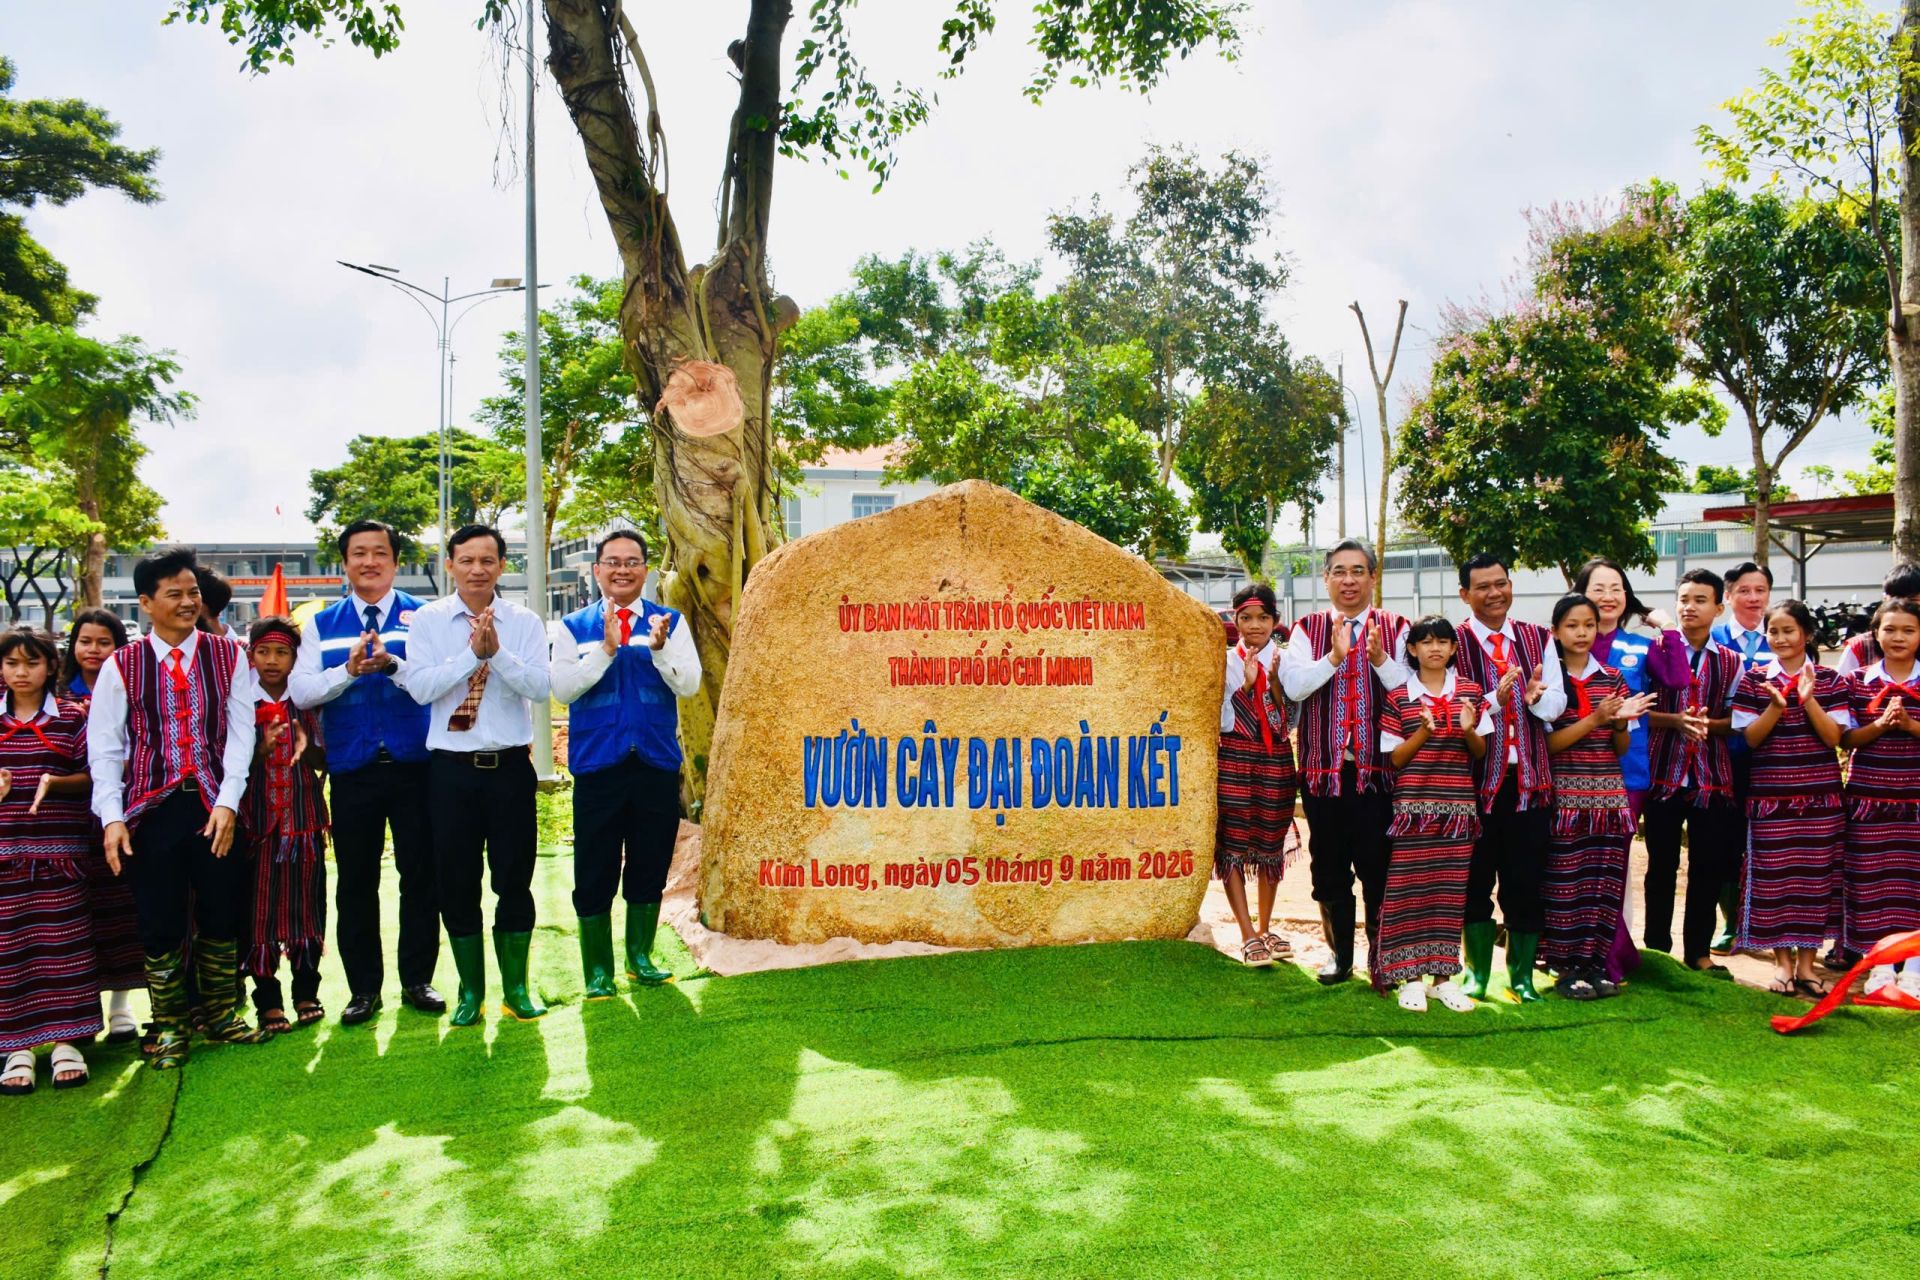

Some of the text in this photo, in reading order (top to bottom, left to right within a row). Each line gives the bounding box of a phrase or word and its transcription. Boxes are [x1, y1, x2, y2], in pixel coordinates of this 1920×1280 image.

[839, 583, 1145, 638] ỦY BAN MẶT TRẬN TỔ QUỐC VIỆT NAM
[889, 640, 1093, 688] THÀNH PHỐ HỒ CHÍ MINH
[803, 711, 1181, 826] VƯỜN CÂY ĐẠI ĐOÀN KẾT
[759, 850, 1193, 891] Kim Long, ngày 05 tháng 9 năm 2026
